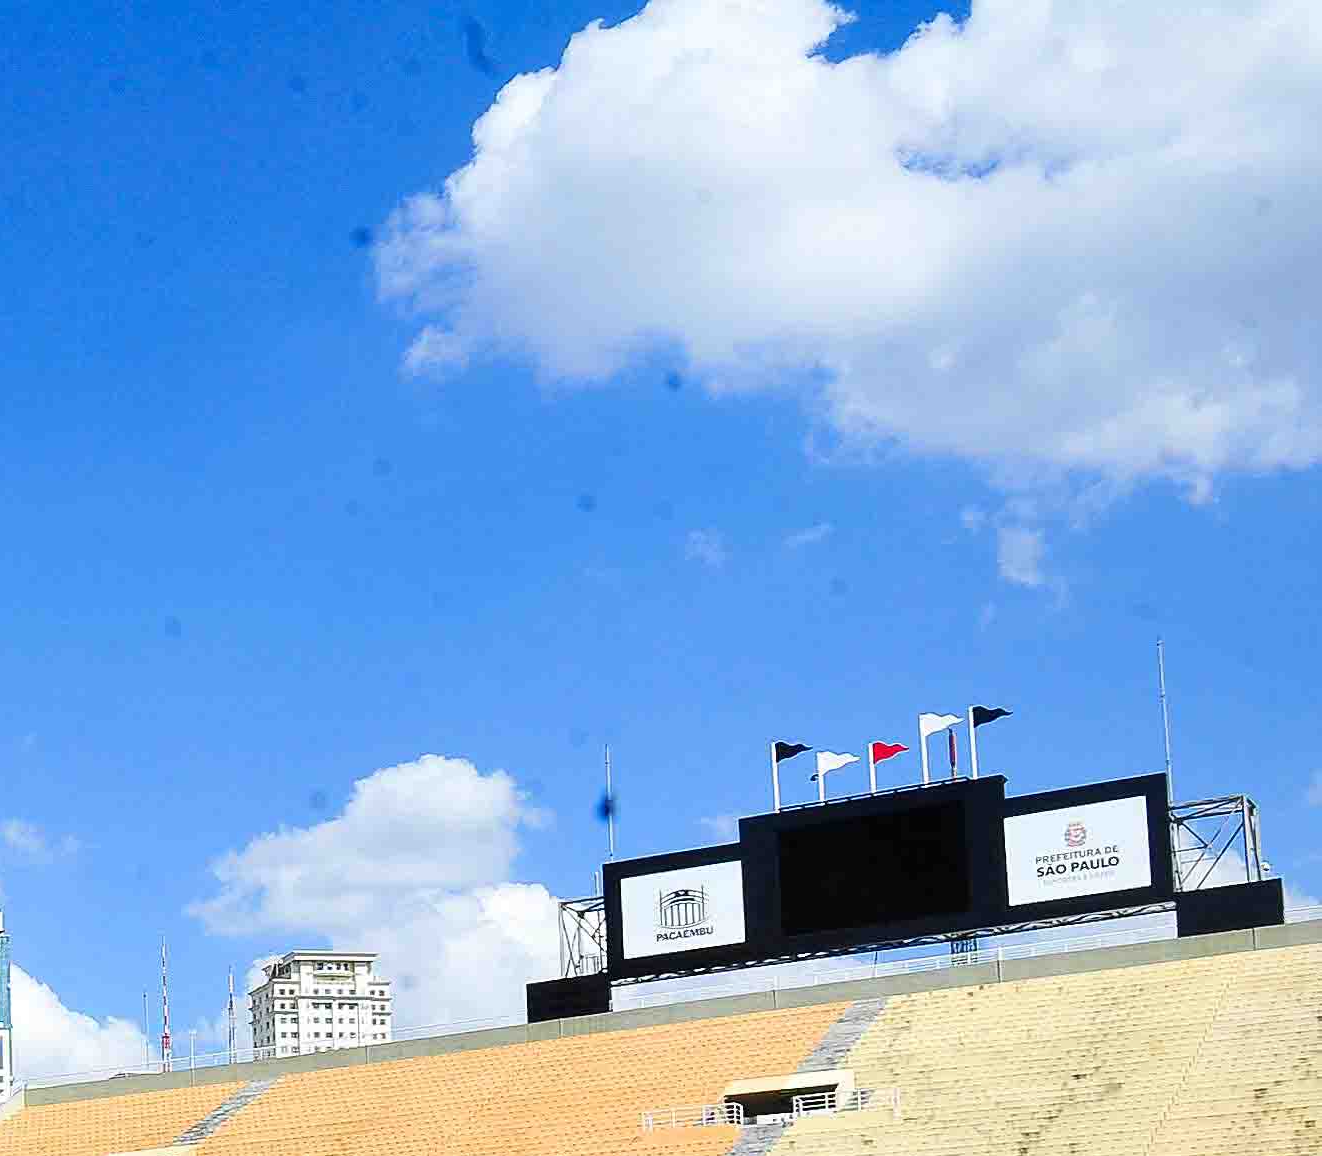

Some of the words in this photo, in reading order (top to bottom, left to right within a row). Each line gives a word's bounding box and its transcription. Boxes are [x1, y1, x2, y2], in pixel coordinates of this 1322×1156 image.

[1035, 847, 1101, 865] PREFEITURA
[1104, 845, 1118, 854] DE
[1036, 863, 1067, 878] SÃO
[1070, 856, 1120, 872] PAULO
[656, 925, 714, 942] PACAEMBU
